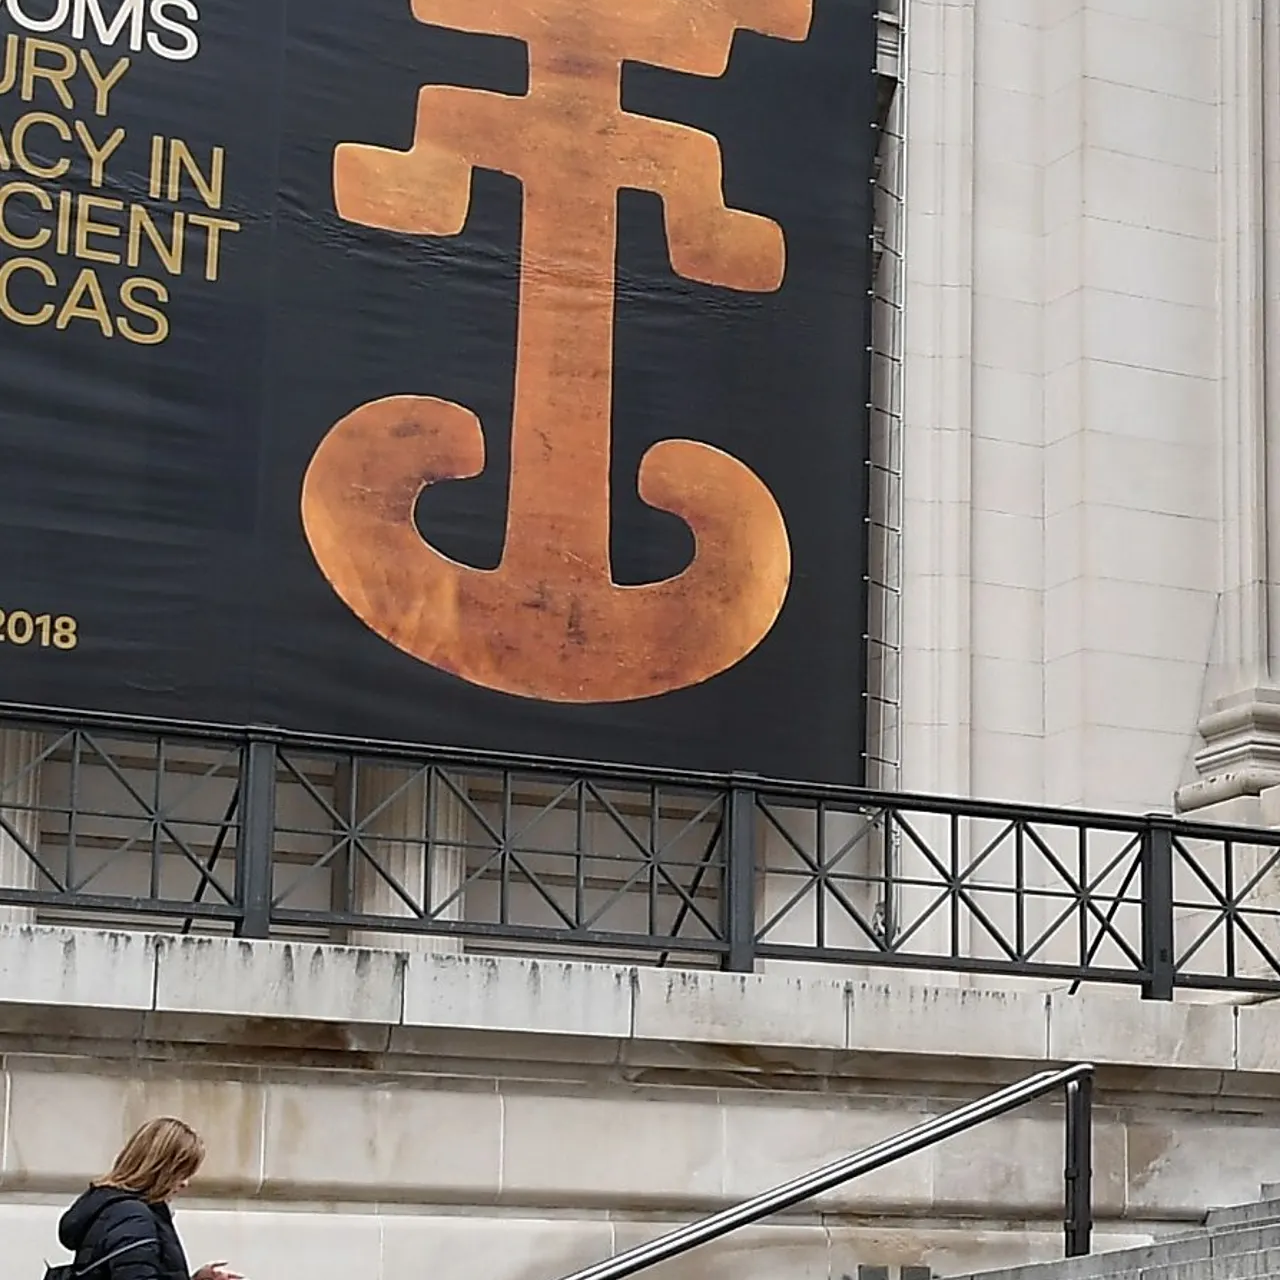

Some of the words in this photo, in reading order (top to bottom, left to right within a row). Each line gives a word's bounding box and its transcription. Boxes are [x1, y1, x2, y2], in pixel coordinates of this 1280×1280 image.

[0, 111, 126, 188] CY
[149, 135, 225, 210] IN
[0, 181, 241, 282] CIENT
[0, 257, 169, 345] CAS
[0, 608, 77, 650] 018
